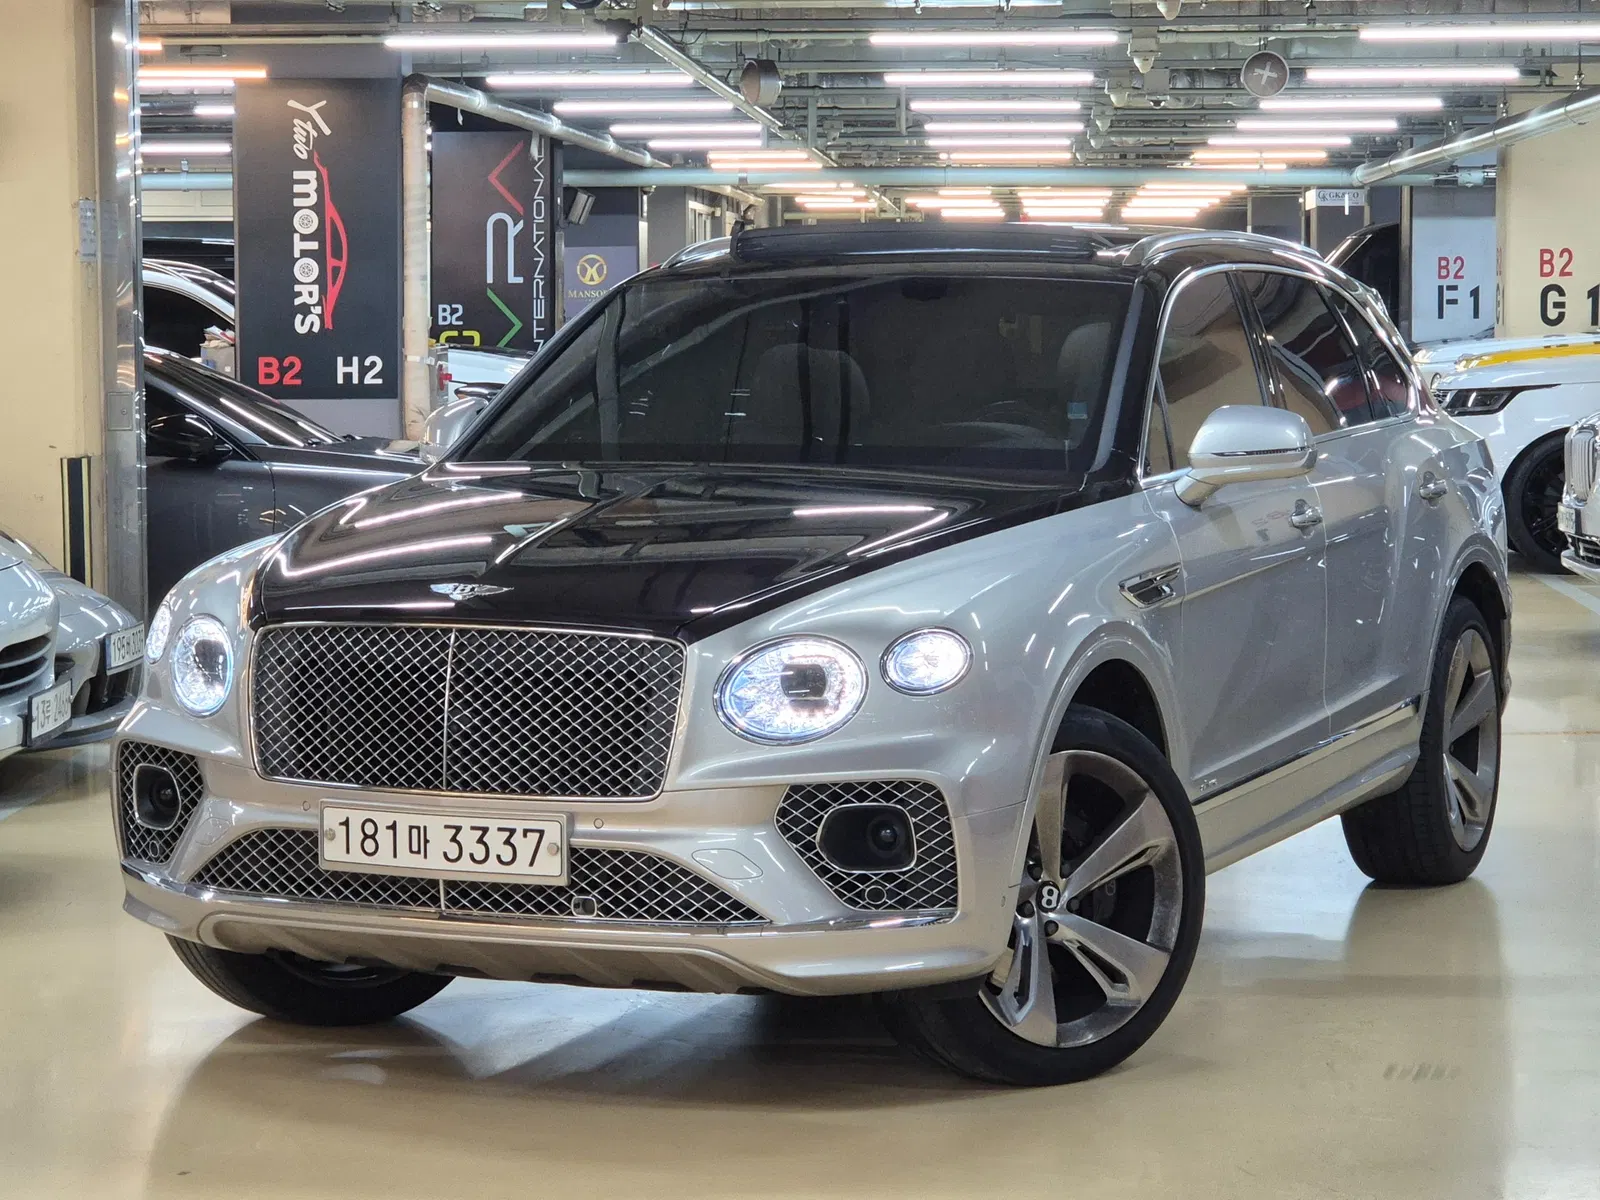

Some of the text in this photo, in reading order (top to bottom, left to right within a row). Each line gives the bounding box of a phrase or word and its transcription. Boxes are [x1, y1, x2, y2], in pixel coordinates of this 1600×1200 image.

[1437, 256, 1466, 280] B2
[1539, 248, 1574, 278] B2
[438, 304, 464, 326] B2
[1437, 284, 1481, 320] F1
[258, 355, 384, 385] B2 H2
[338, 815, 546, 868] 181마 3337
